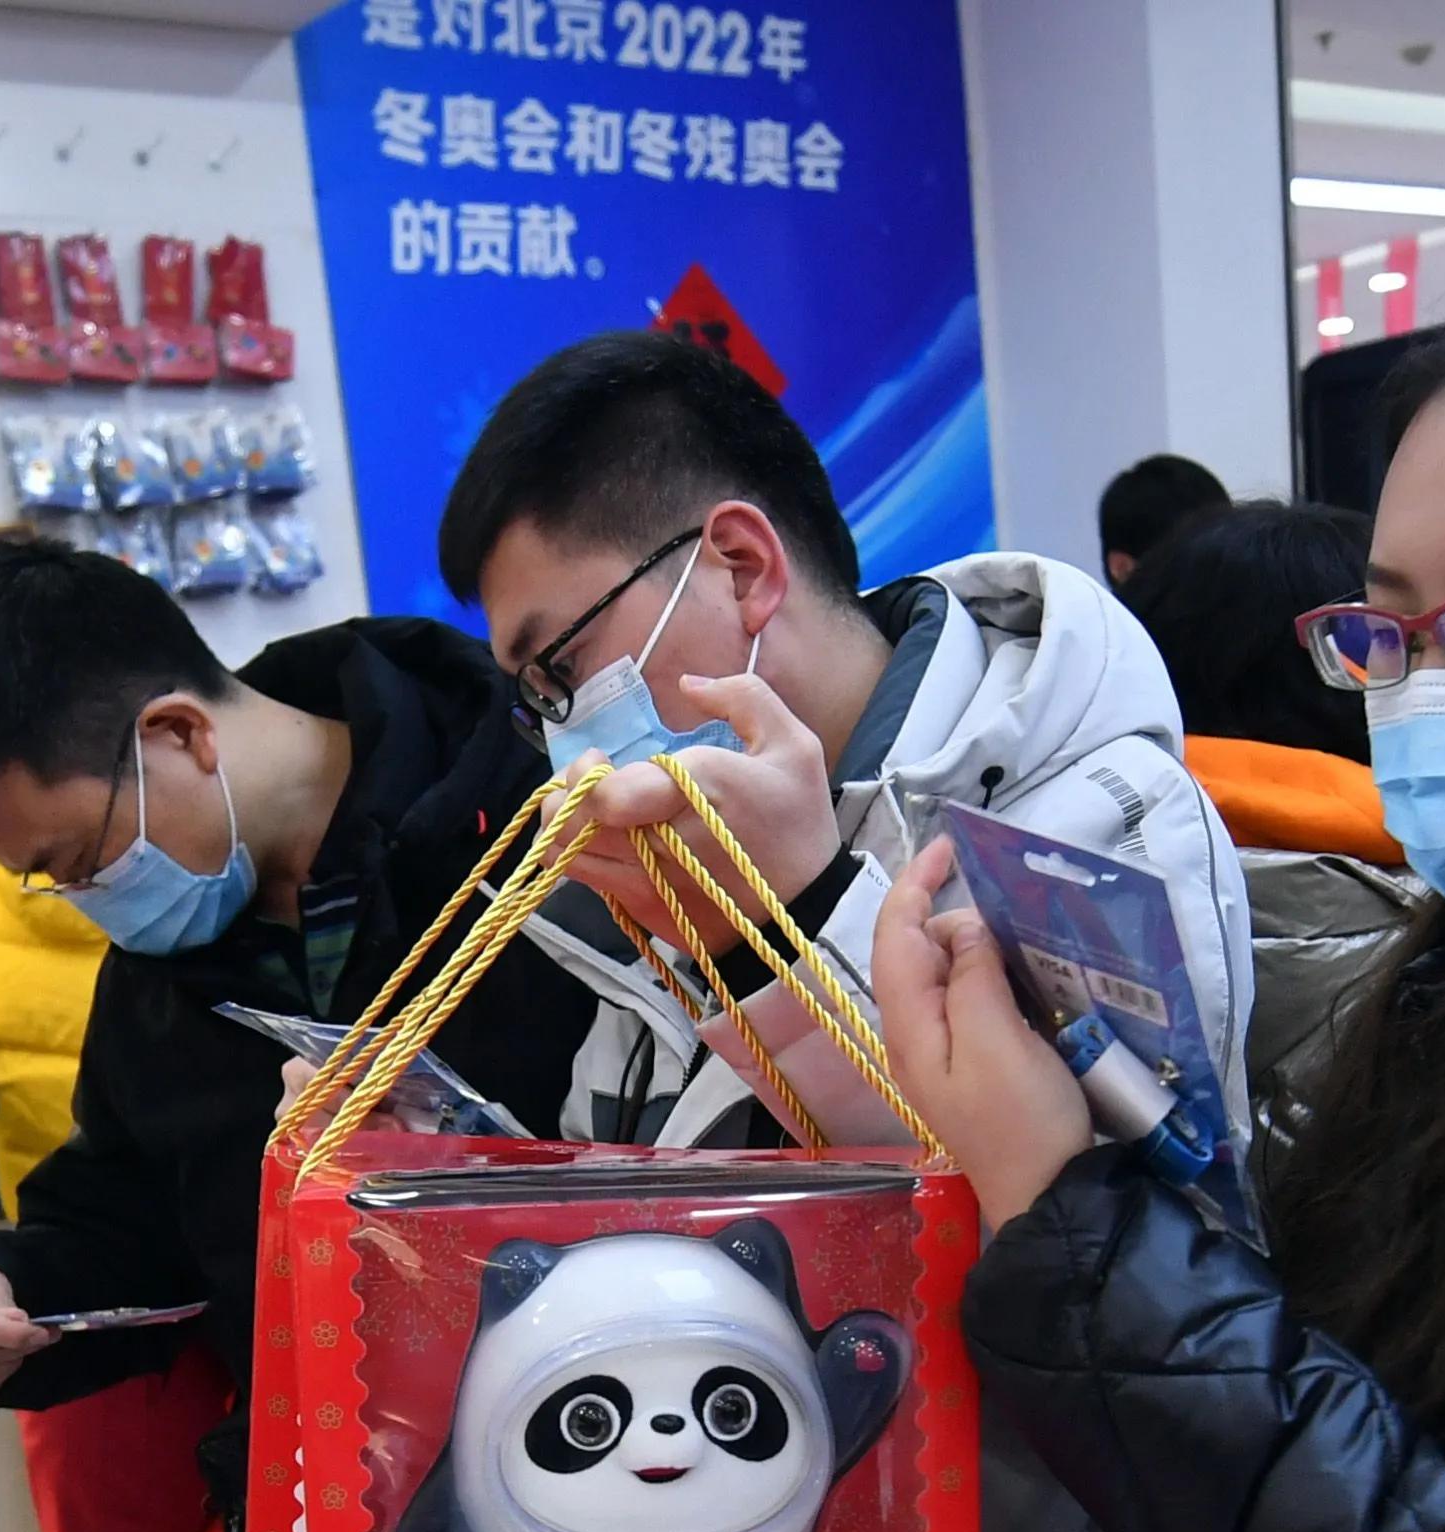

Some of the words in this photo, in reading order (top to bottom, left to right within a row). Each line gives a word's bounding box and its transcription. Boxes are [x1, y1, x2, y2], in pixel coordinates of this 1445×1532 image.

[372, 88, 844, 192] 冬奥会和冬残奥会
[389, 199, 605, 281] 的贡献。
